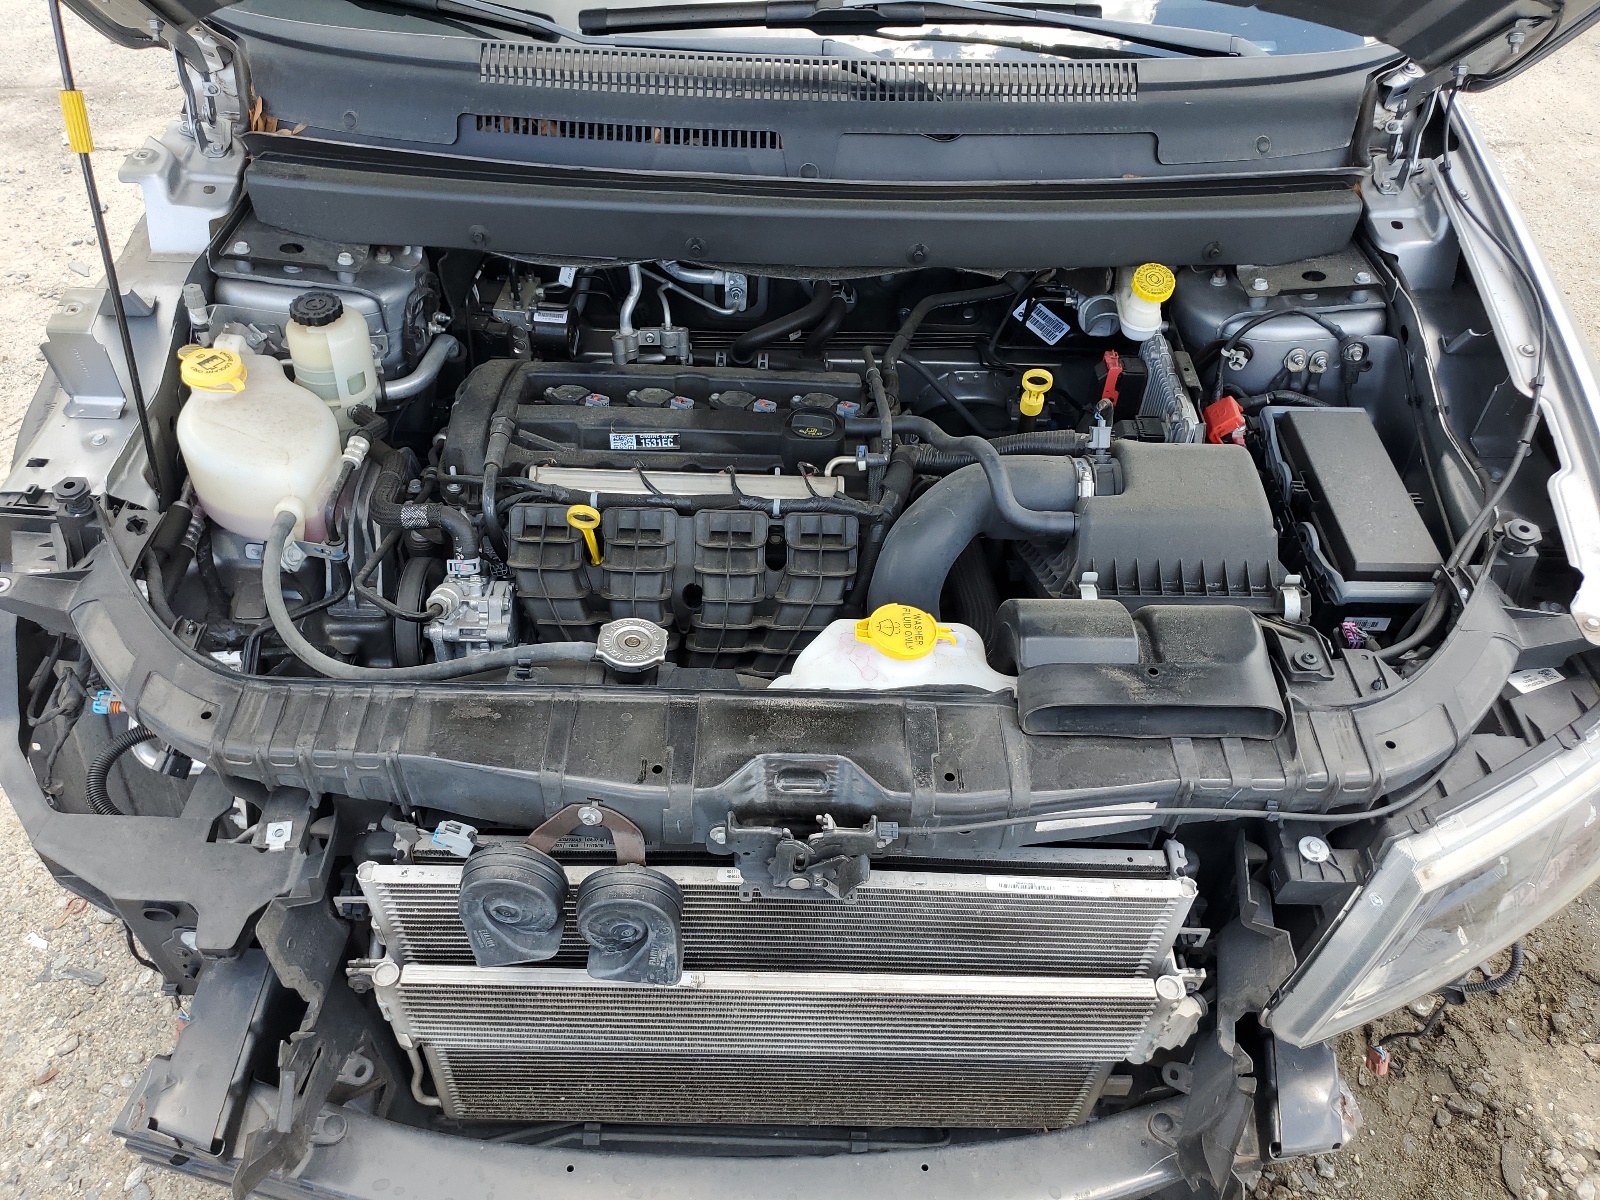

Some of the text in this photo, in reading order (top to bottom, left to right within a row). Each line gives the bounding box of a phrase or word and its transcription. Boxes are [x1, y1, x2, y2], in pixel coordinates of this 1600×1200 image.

[641, 438, 673, 447] 1531EC
[902, 607, 914, 650] FLUID ONLY
[913, 613, 924, 646] WASHER
